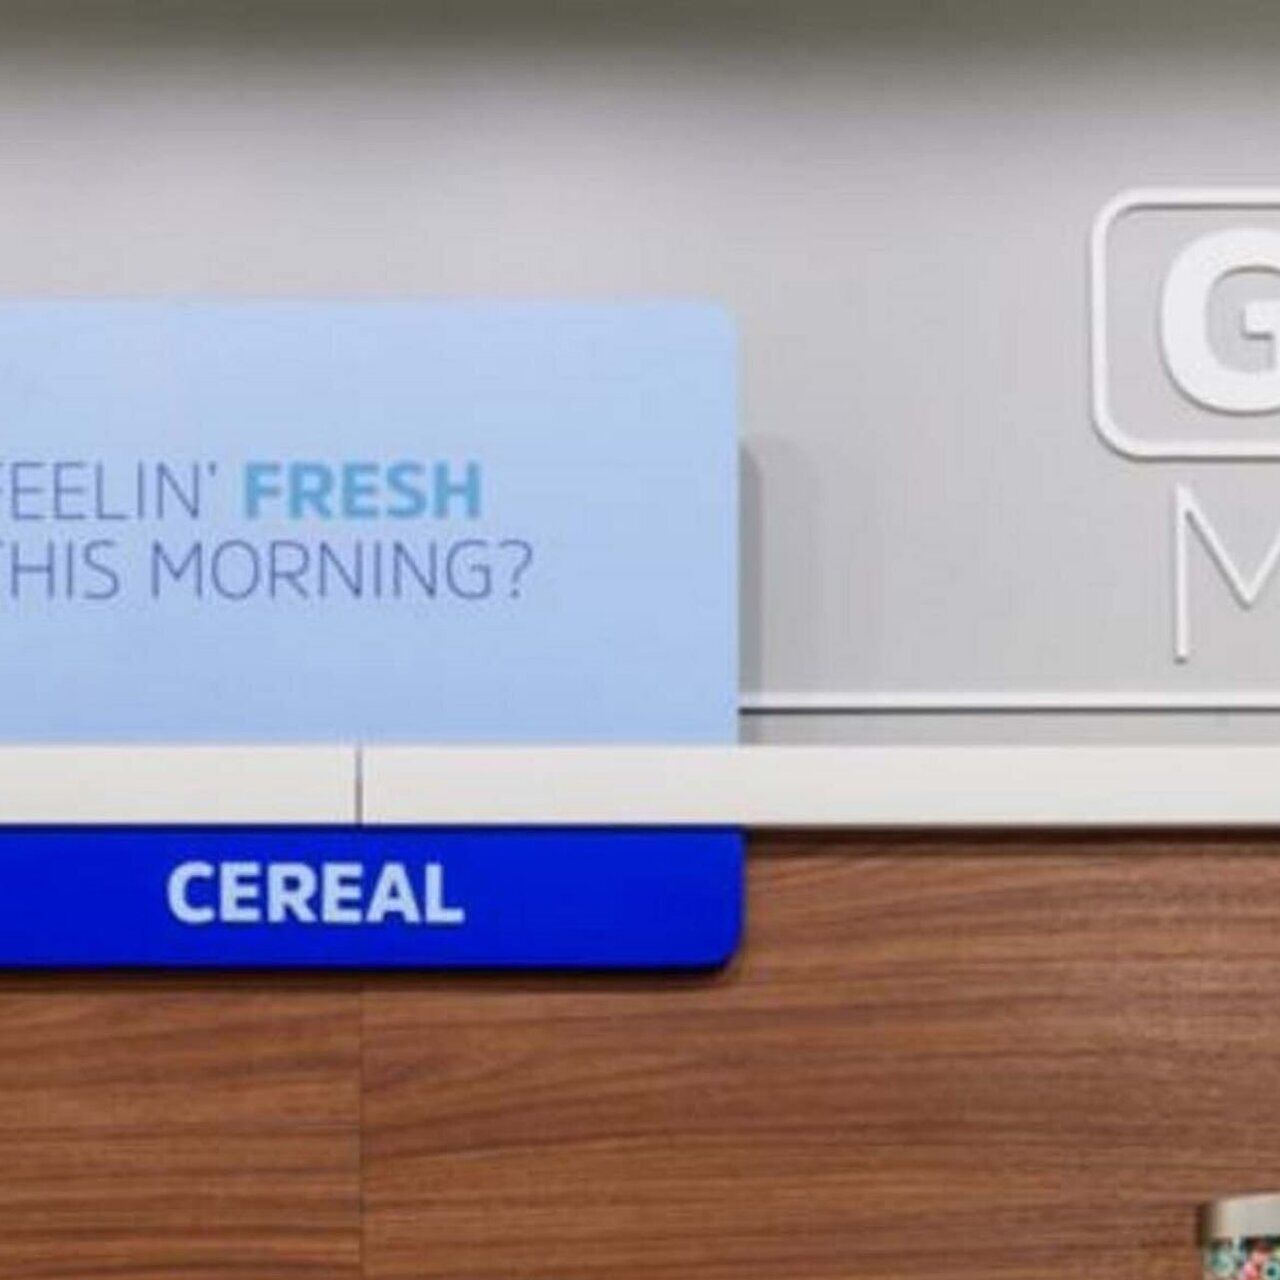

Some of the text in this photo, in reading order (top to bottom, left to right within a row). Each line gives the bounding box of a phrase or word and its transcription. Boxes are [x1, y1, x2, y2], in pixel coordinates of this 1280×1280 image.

[242, 461, 484, 520] FRESH
[150, 539, 534, 600] MORNING?
[167, 860, 466, 924] CEREAL
